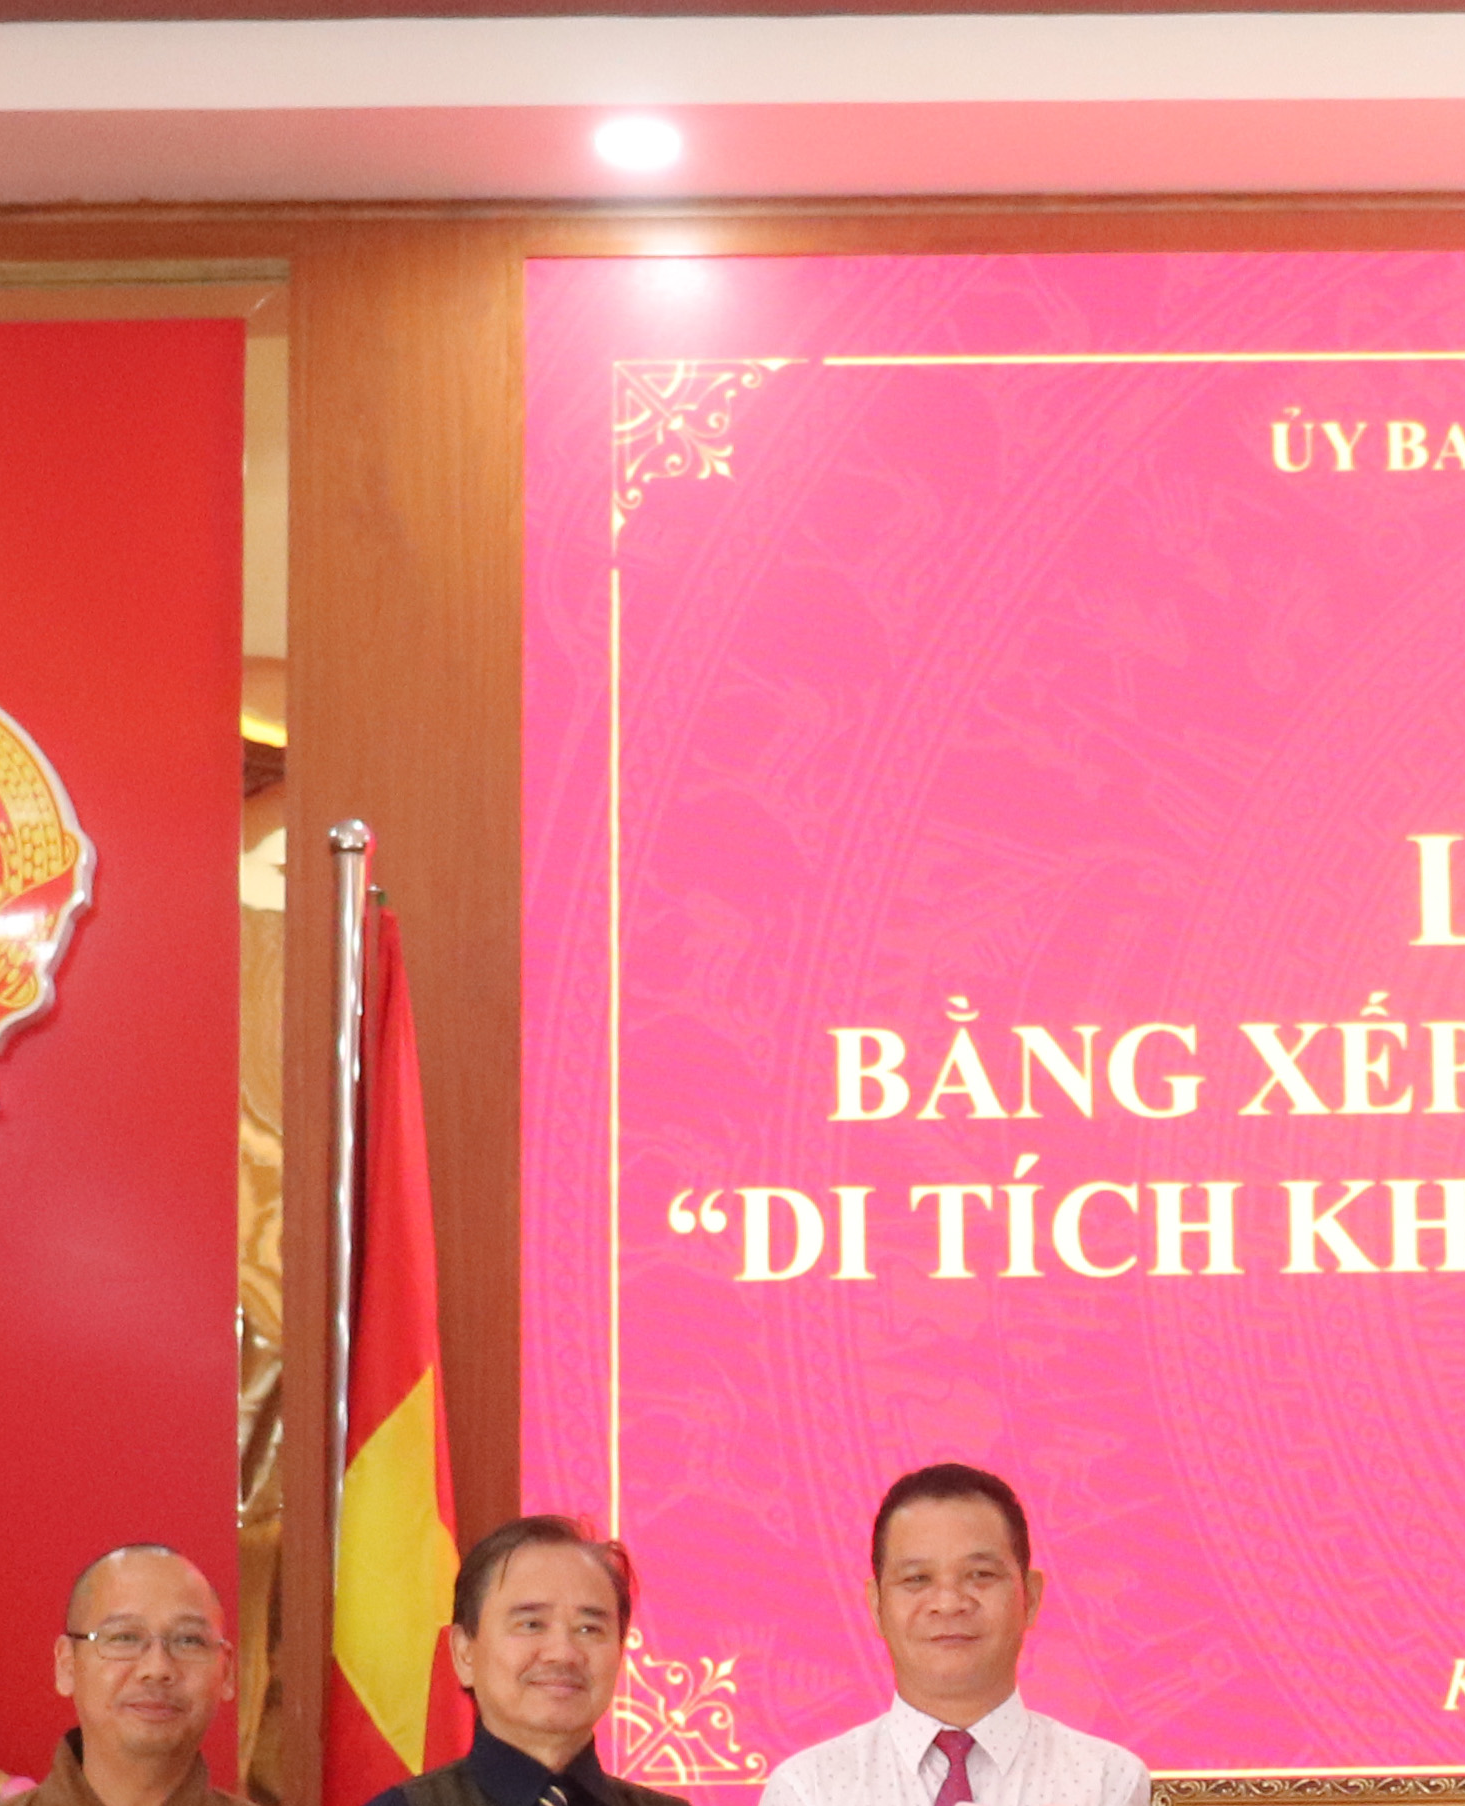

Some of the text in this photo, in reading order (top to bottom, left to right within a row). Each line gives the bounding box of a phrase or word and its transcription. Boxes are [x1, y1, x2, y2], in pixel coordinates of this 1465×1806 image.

[1270, 406, 1368, 474] ỦY
[827, 994, 1206, 1123] BẰNG
[667, 1185, 876, 1283] “DI
[909, 1152, 1245, 1280] TÍCH
